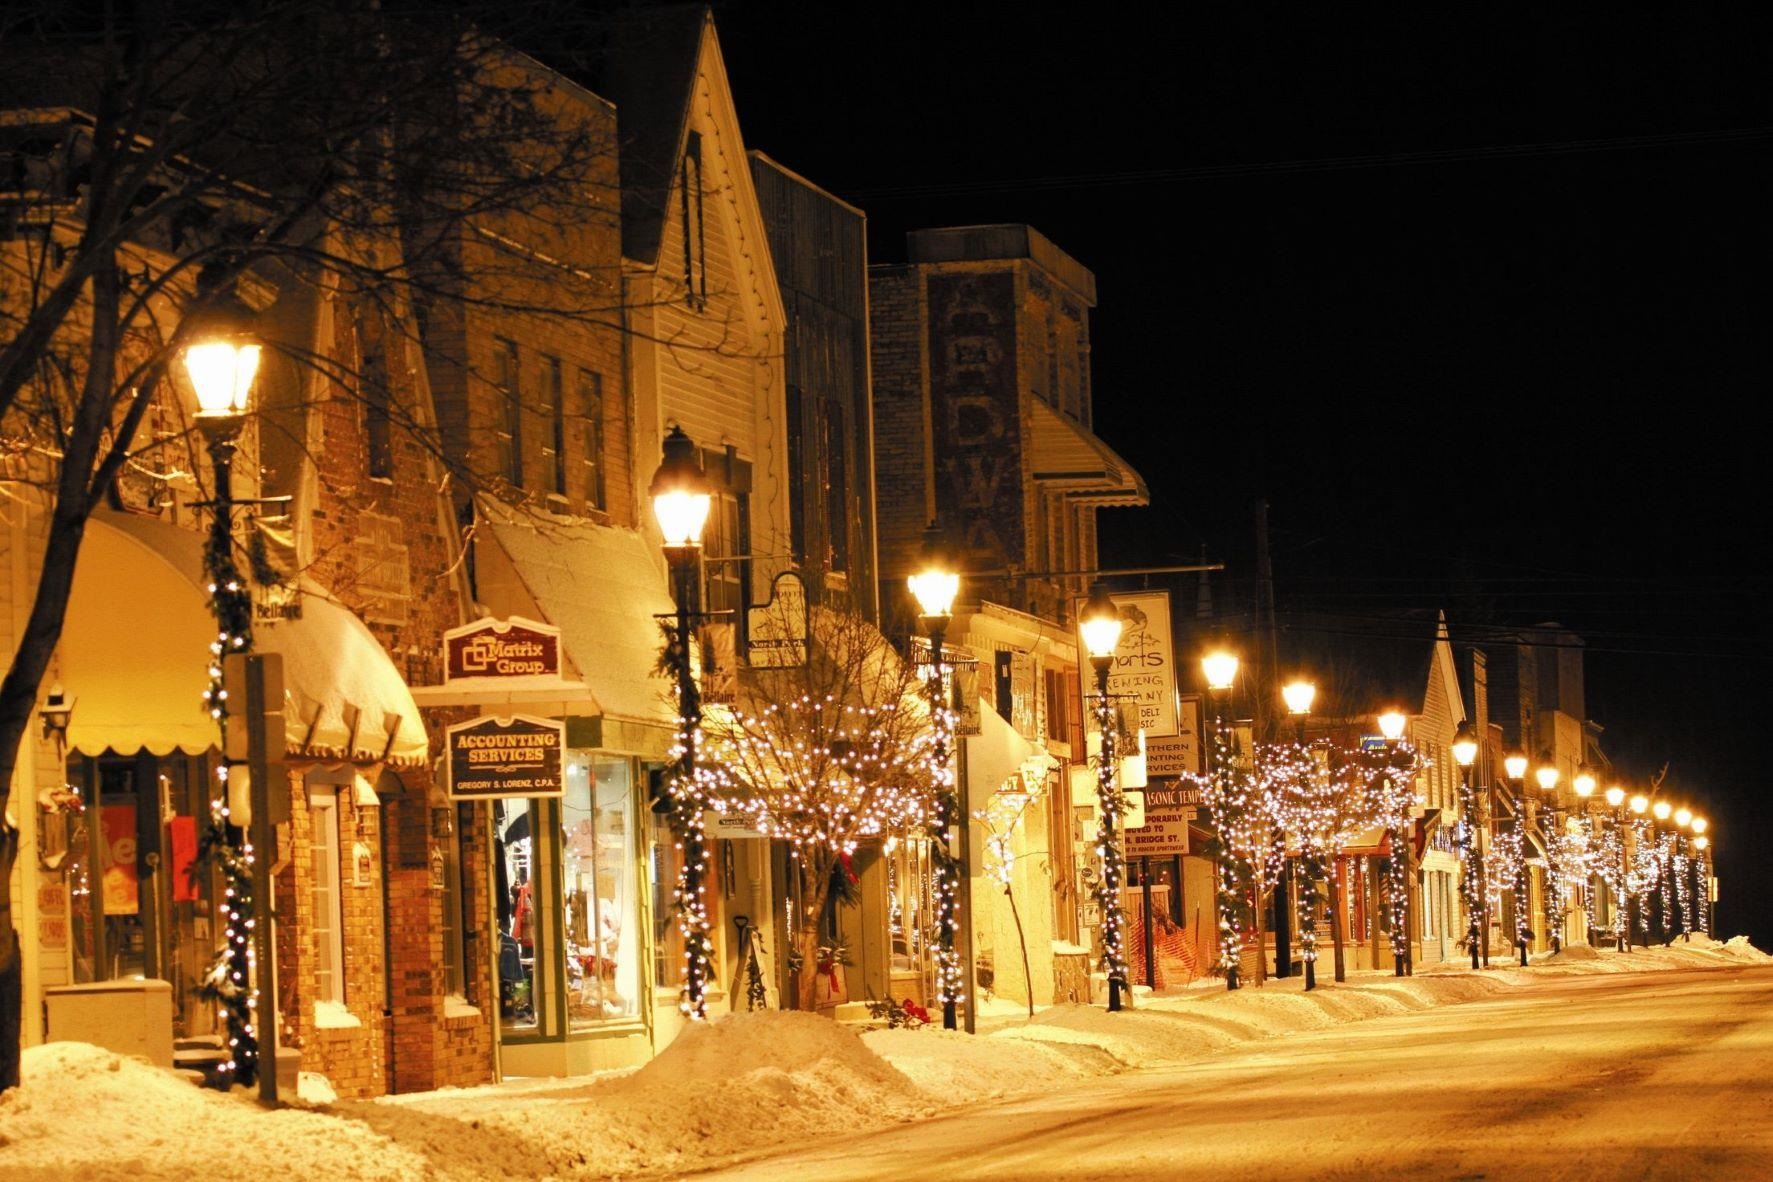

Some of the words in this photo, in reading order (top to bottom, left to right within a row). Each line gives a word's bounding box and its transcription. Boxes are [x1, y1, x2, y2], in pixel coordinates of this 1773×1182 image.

[488, 641, 543, 657] Matrix
[1115, 646, 1163, 668] orts
[497, 660, 544, 675] Group
[1141, 708, 1160, 717] DELI
[1140, 720, 1155, 728] SIC
[457, 734, 556, 748] ACCOUNTING
[469, 747, 544, 762] SERVICES
[1146, 763, 1186, 772] RVICES
[457, 781, 491, 790] GREGORY
[493, 780, 501, 788] S.
[1146, 791, 1177, 806] ASONIC
[1145, 814, 1182, 823] PORARILY
[1154, 825, 1164, 833] TO
[1135, 835, 1164, 844] BRIDGE
[1168, 834, 1180, 842] ST.
